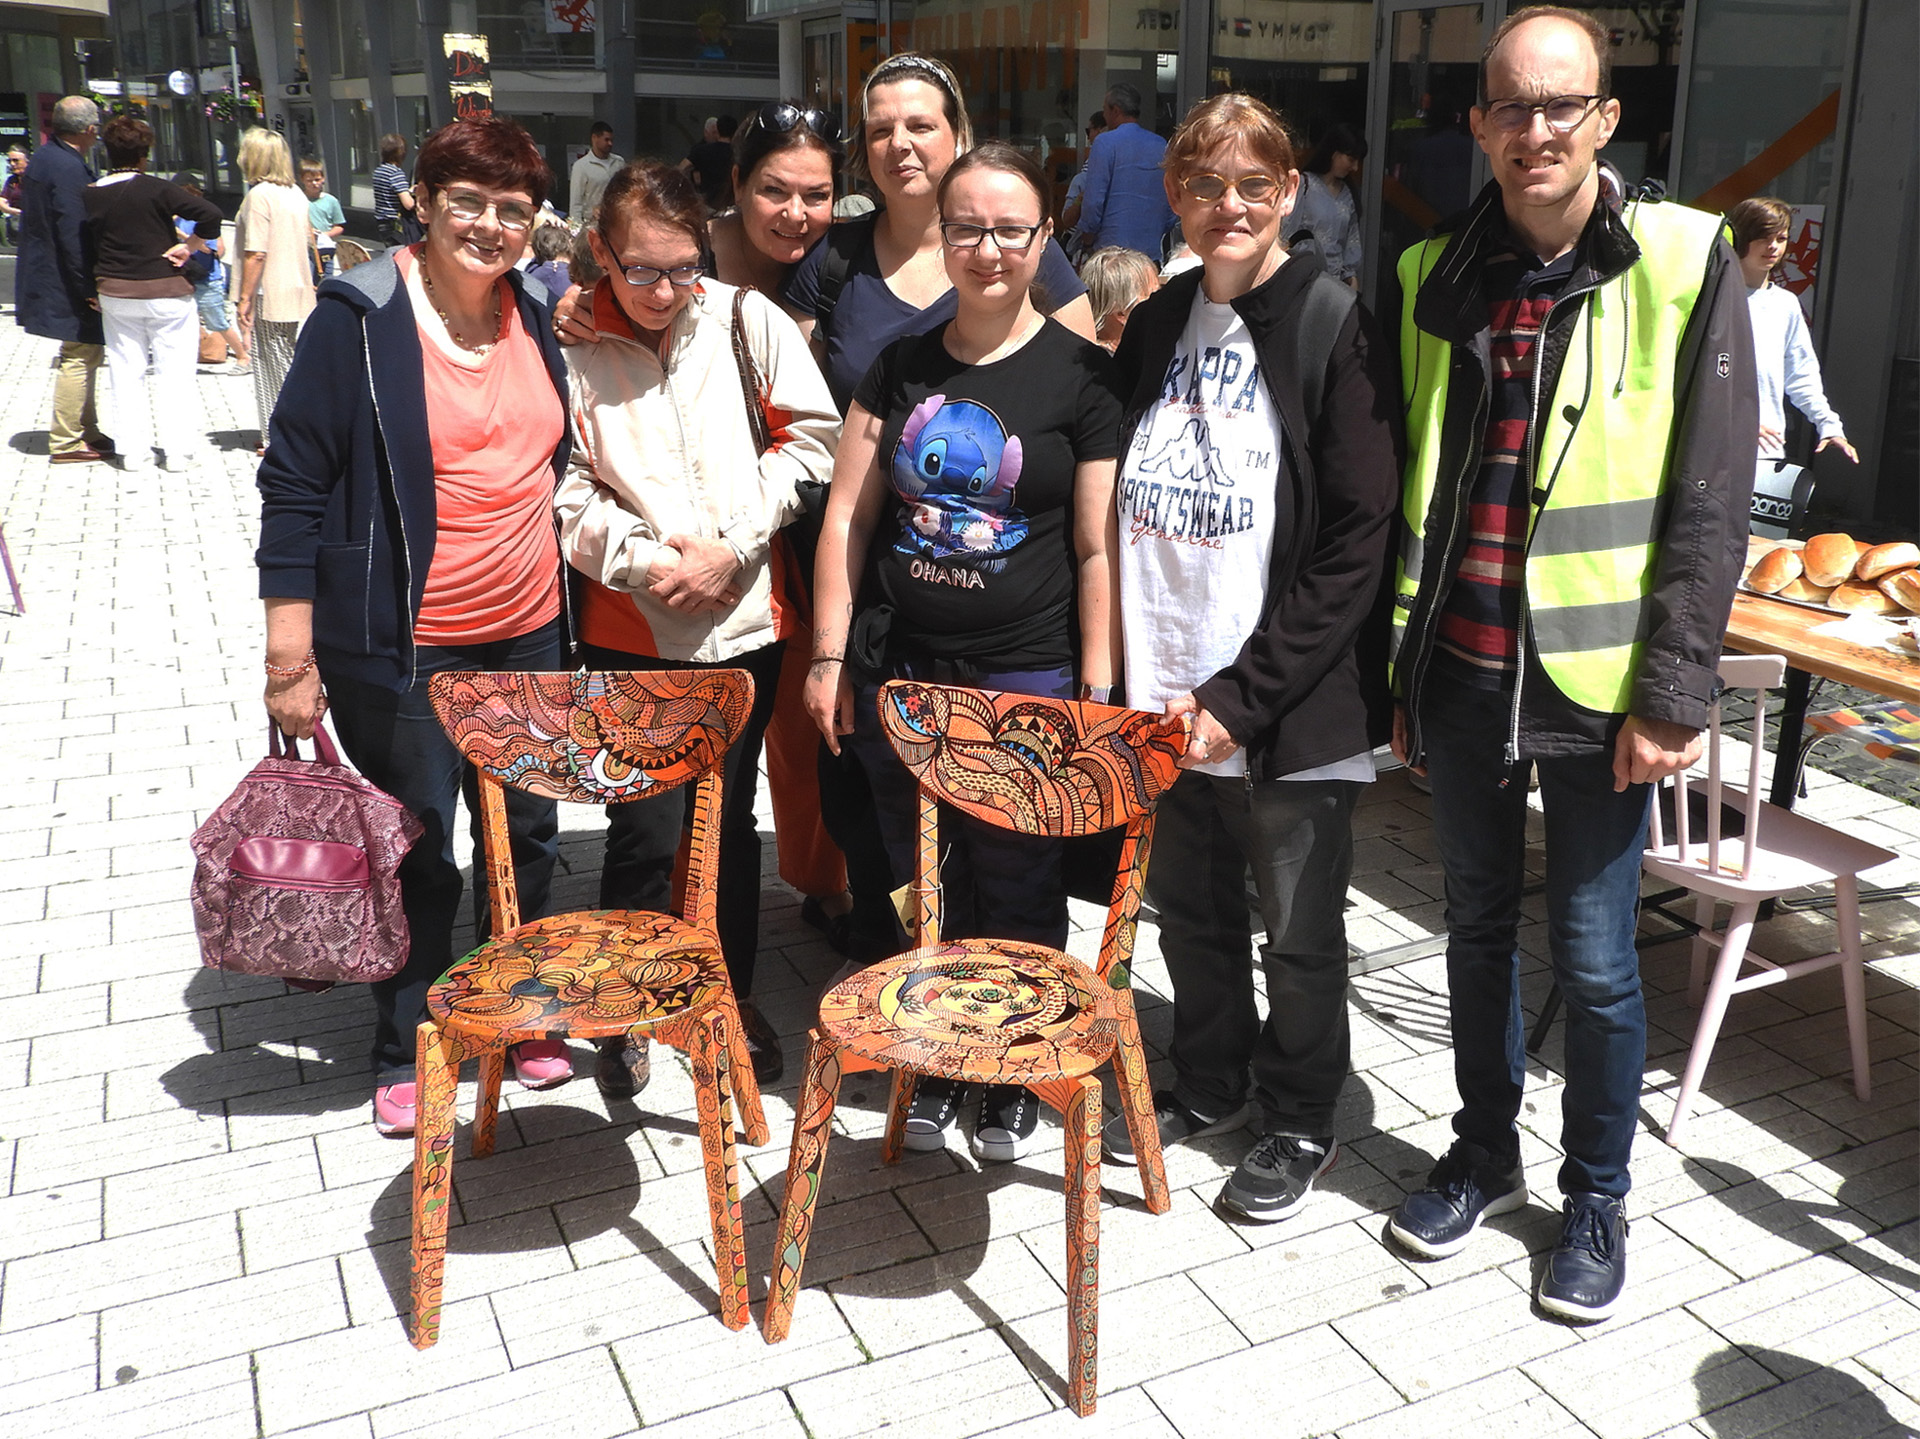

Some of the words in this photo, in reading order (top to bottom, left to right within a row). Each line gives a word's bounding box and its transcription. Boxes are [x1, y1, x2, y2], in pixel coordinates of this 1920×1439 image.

[453, 50, 485, 76] Die
[1161, 346, 1259, 413] KAPPA
[1245, 449, 1271, 469] TM
[1117, 476, 1255, 538] SPORTSWEAR
[1130, 509, 1224, 550] Genuine
[910, 558, 986, 590] OHANA
